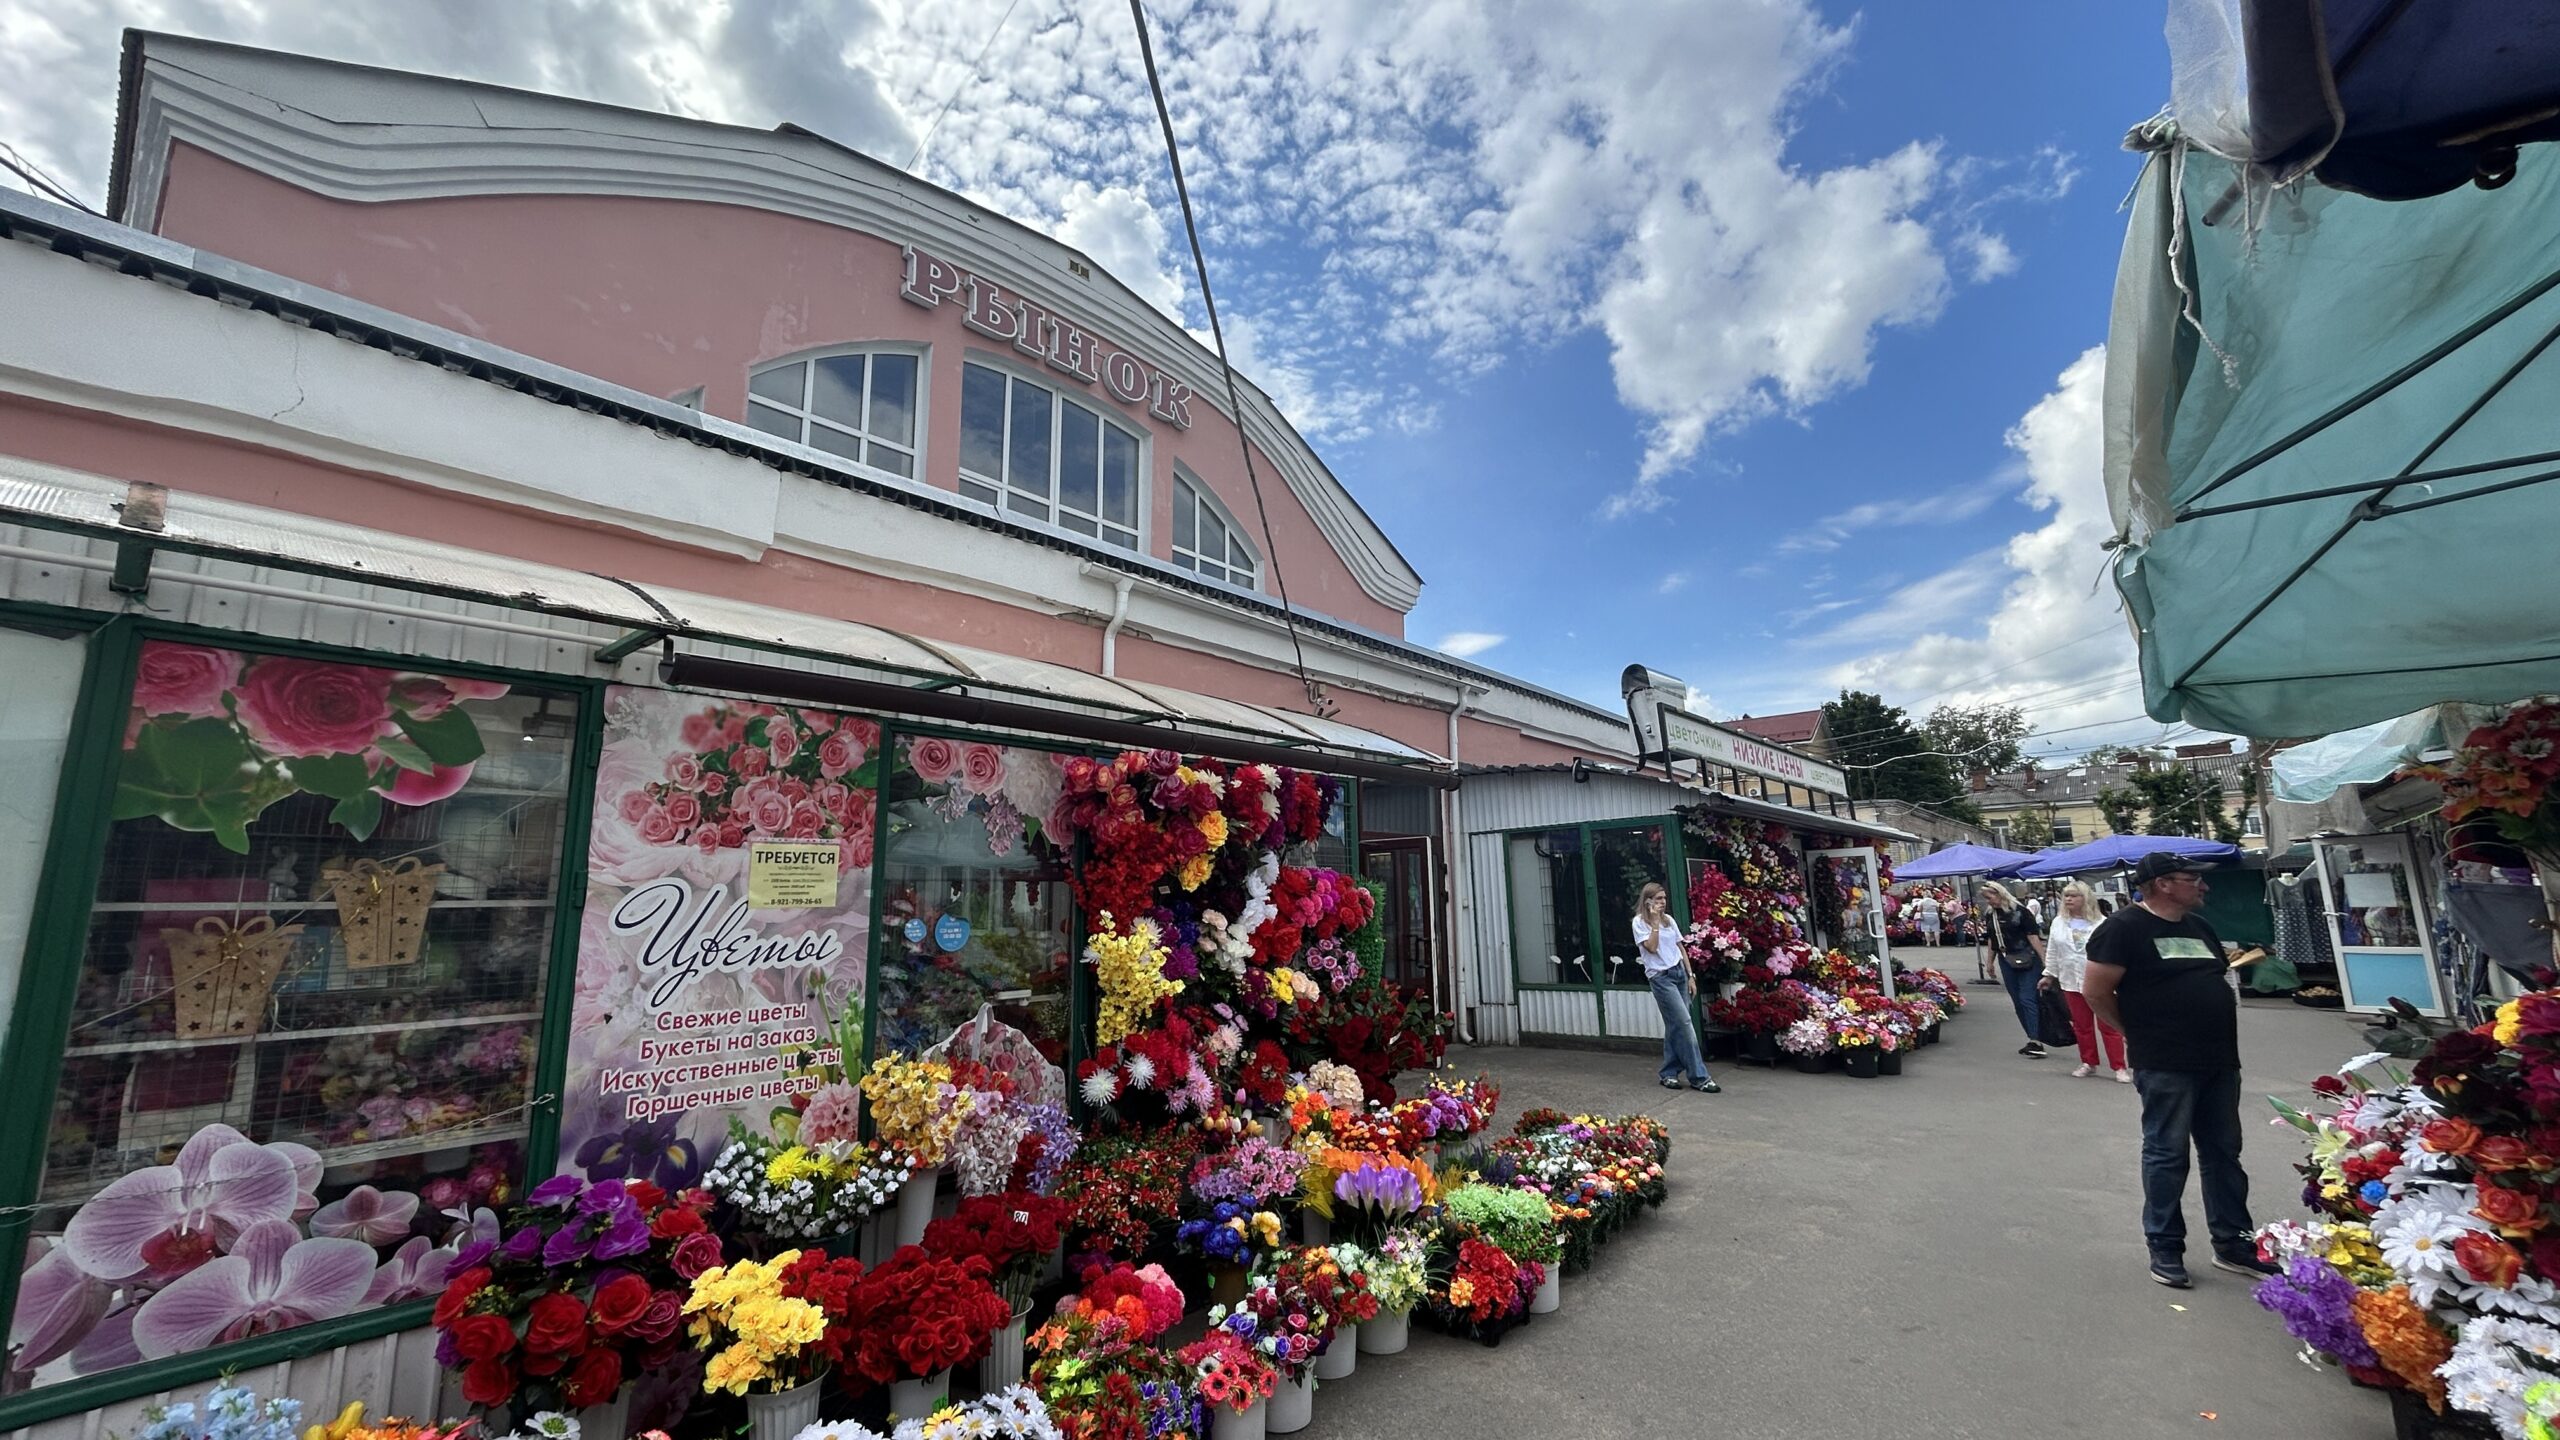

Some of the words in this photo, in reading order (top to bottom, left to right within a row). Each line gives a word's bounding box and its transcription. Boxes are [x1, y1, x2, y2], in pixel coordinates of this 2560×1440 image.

[901, 242, 1192, 431] РЫНОК
[1733, 739, 1775, 771] НИЗКИЕ
[1776, 753, 1804, 779] ЦЕНЫ
[755, 851, 835, 865] ТРЕБУЕТСЯ
[614, 883, 837, 1008] Цветы
[656, 1011, 742, 1030] Свежие
[747, 1004, 806, 1025] цветы
[640, 1041, 720, 1065] Букеты
[727, 1035, 753, 1052] на
[758, 1028, 816, 1047] заказ
[602, 1056, 779, 1093] Искусственные
[784, 1050, 841, 1071] цеты
[627, 1084, 754, 1120] Горшечные
[759, 1076, 819, 1098] цветы
